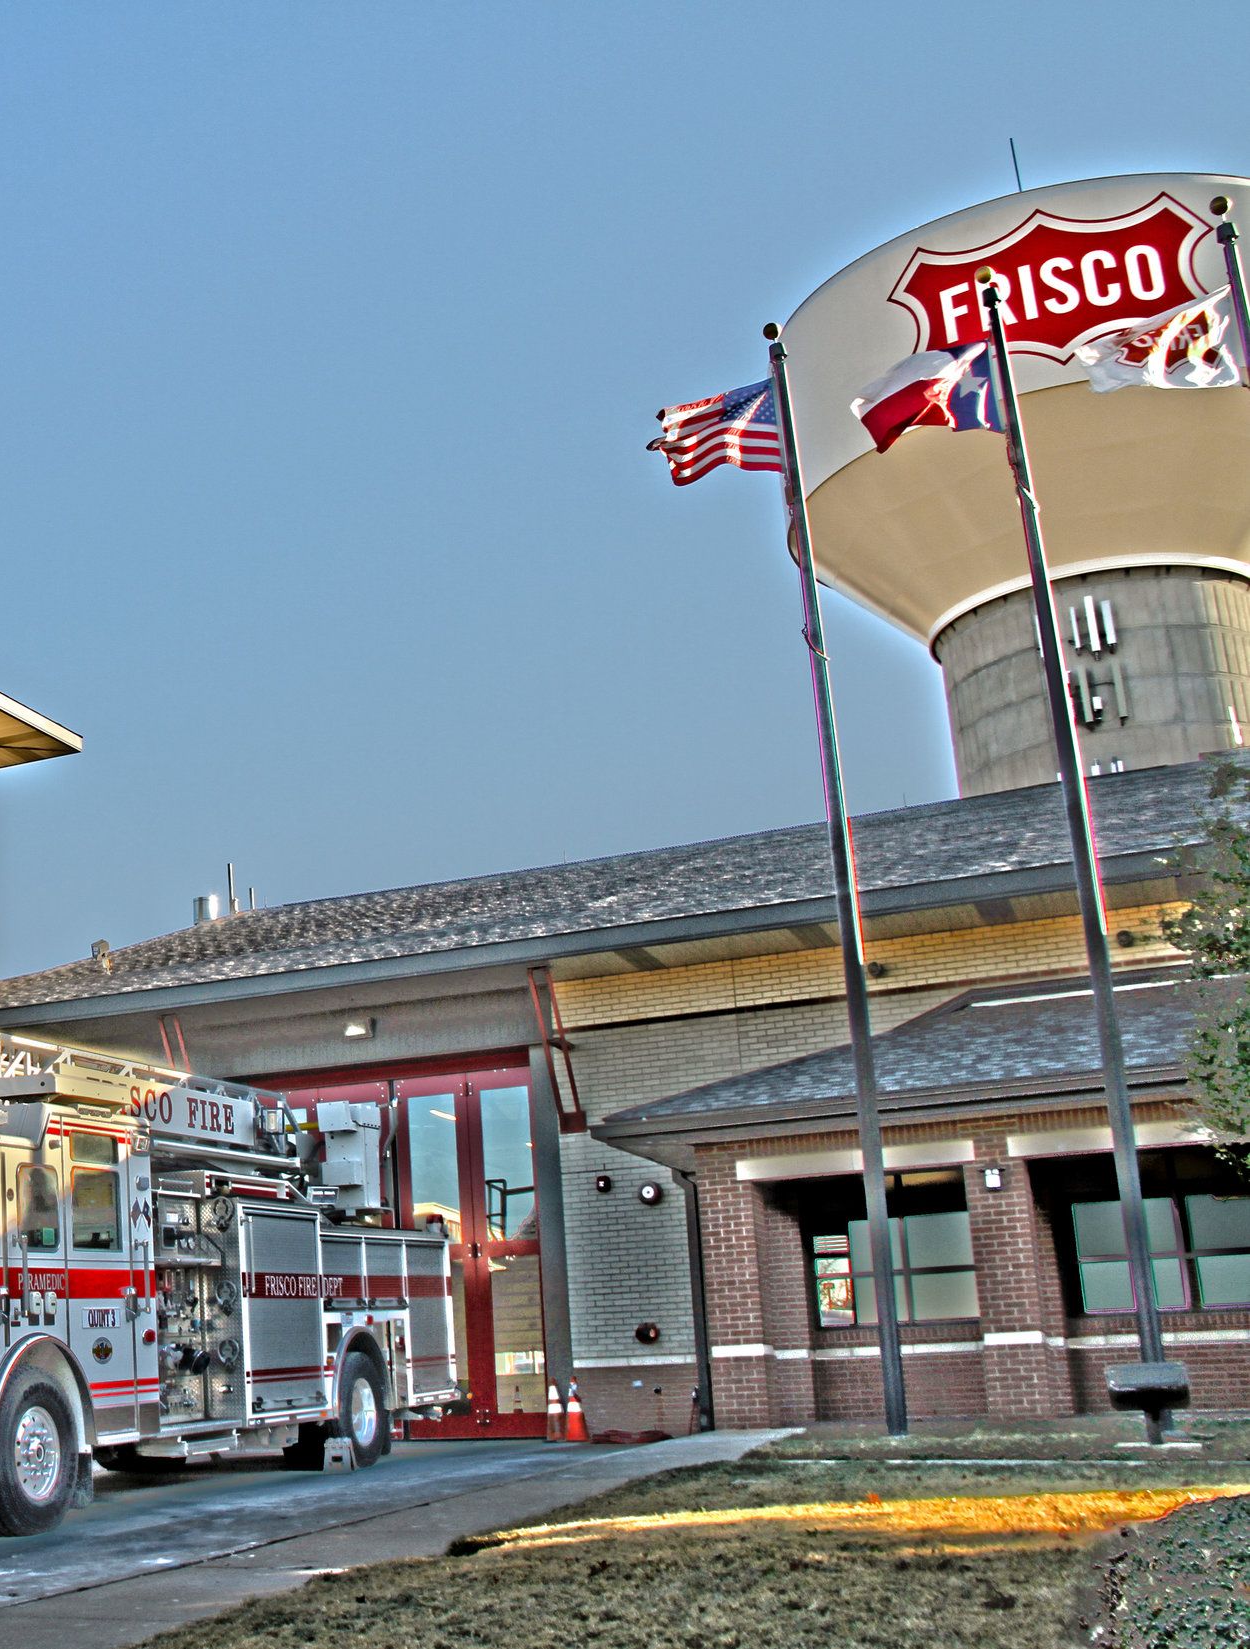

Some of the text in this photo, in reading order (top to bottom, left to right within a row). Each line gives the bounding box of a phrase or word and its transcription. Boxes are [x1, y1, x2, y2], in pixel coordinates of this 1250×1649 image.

[939, 244, 1166, 344] FRISCO
[187, 1097, 234, 1134] FIRE
[18, 1273, 66, 1290] PRAMEDIC
[264, 1275, 343, 1297] FRISCO FIRE DEPT
[88, 1309, 116, 1327] QUINT 3
